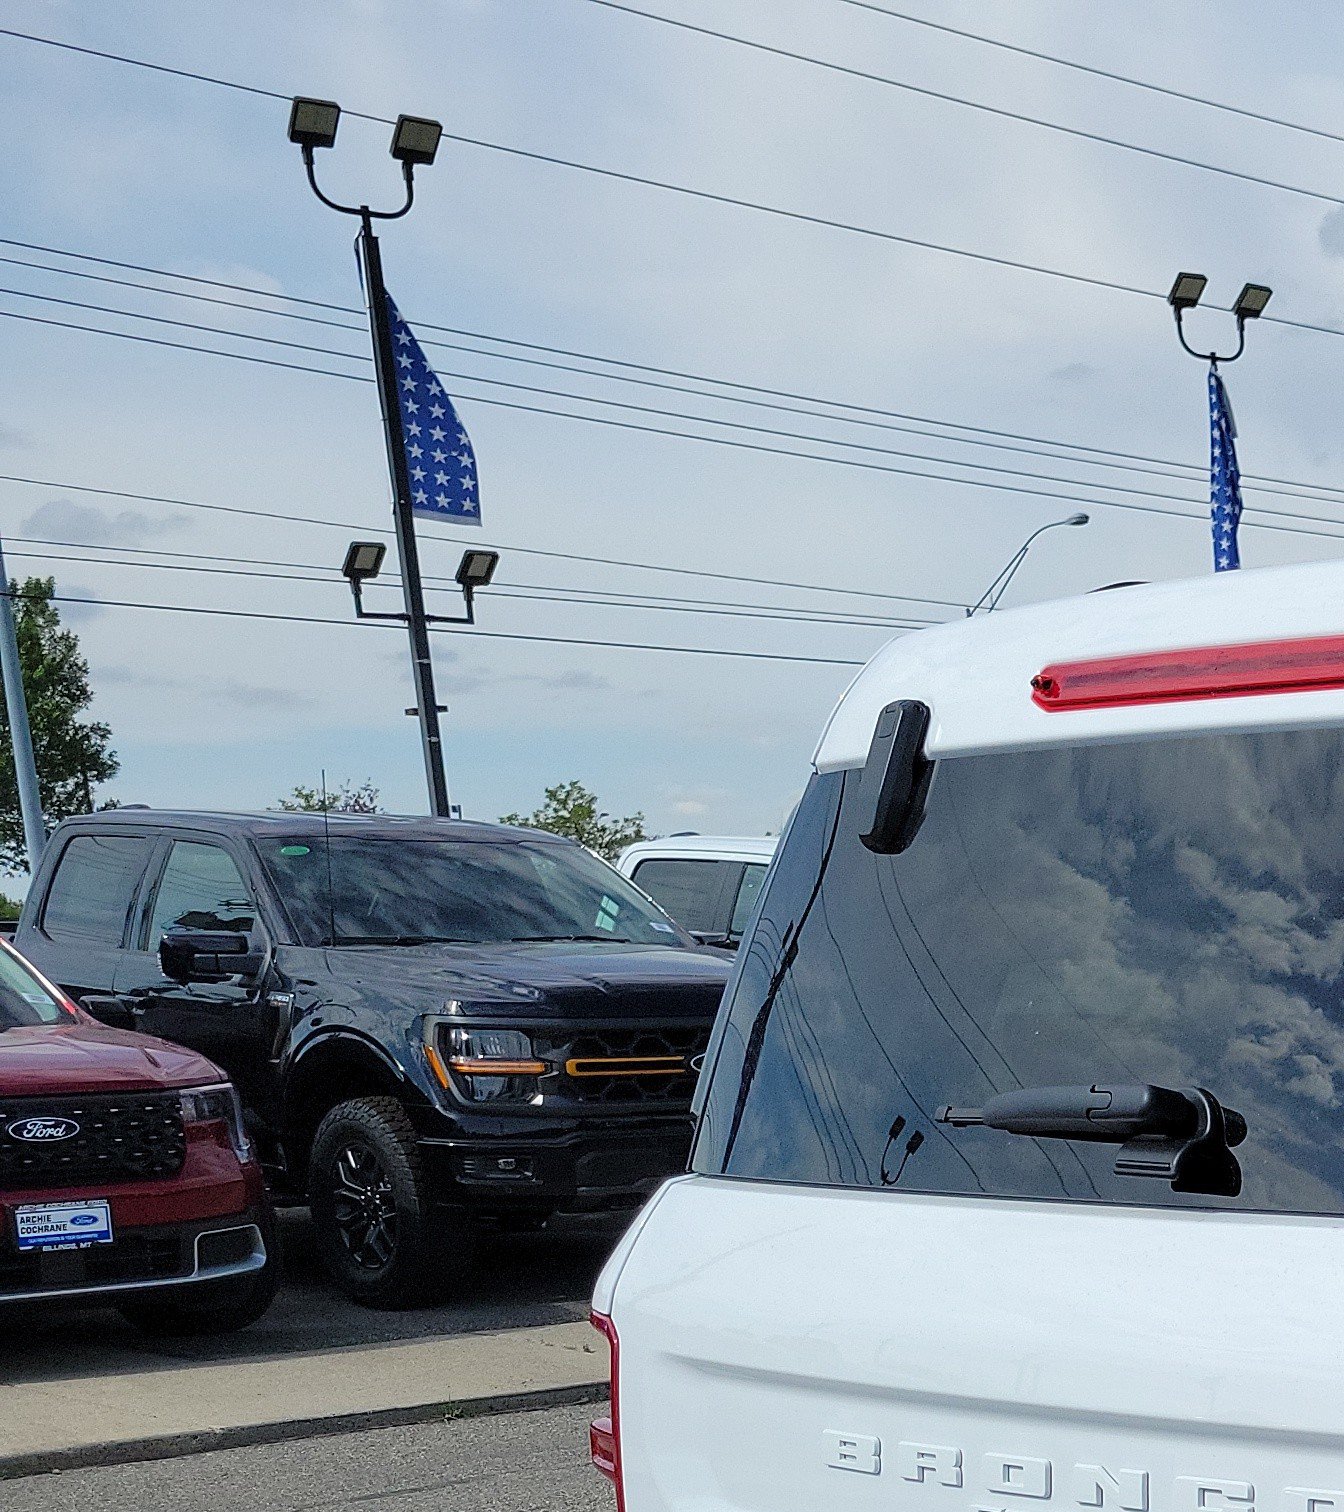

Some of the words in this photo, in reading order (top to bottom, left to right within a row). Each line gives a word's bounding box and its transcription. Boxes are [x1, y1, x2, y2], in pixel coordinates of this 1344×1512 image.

[23, 1120, 66, 1138] Ford
[20, 1214, 52, 1224] ARCHIE
[20, 1224, 68, 1235] COCHRANE
